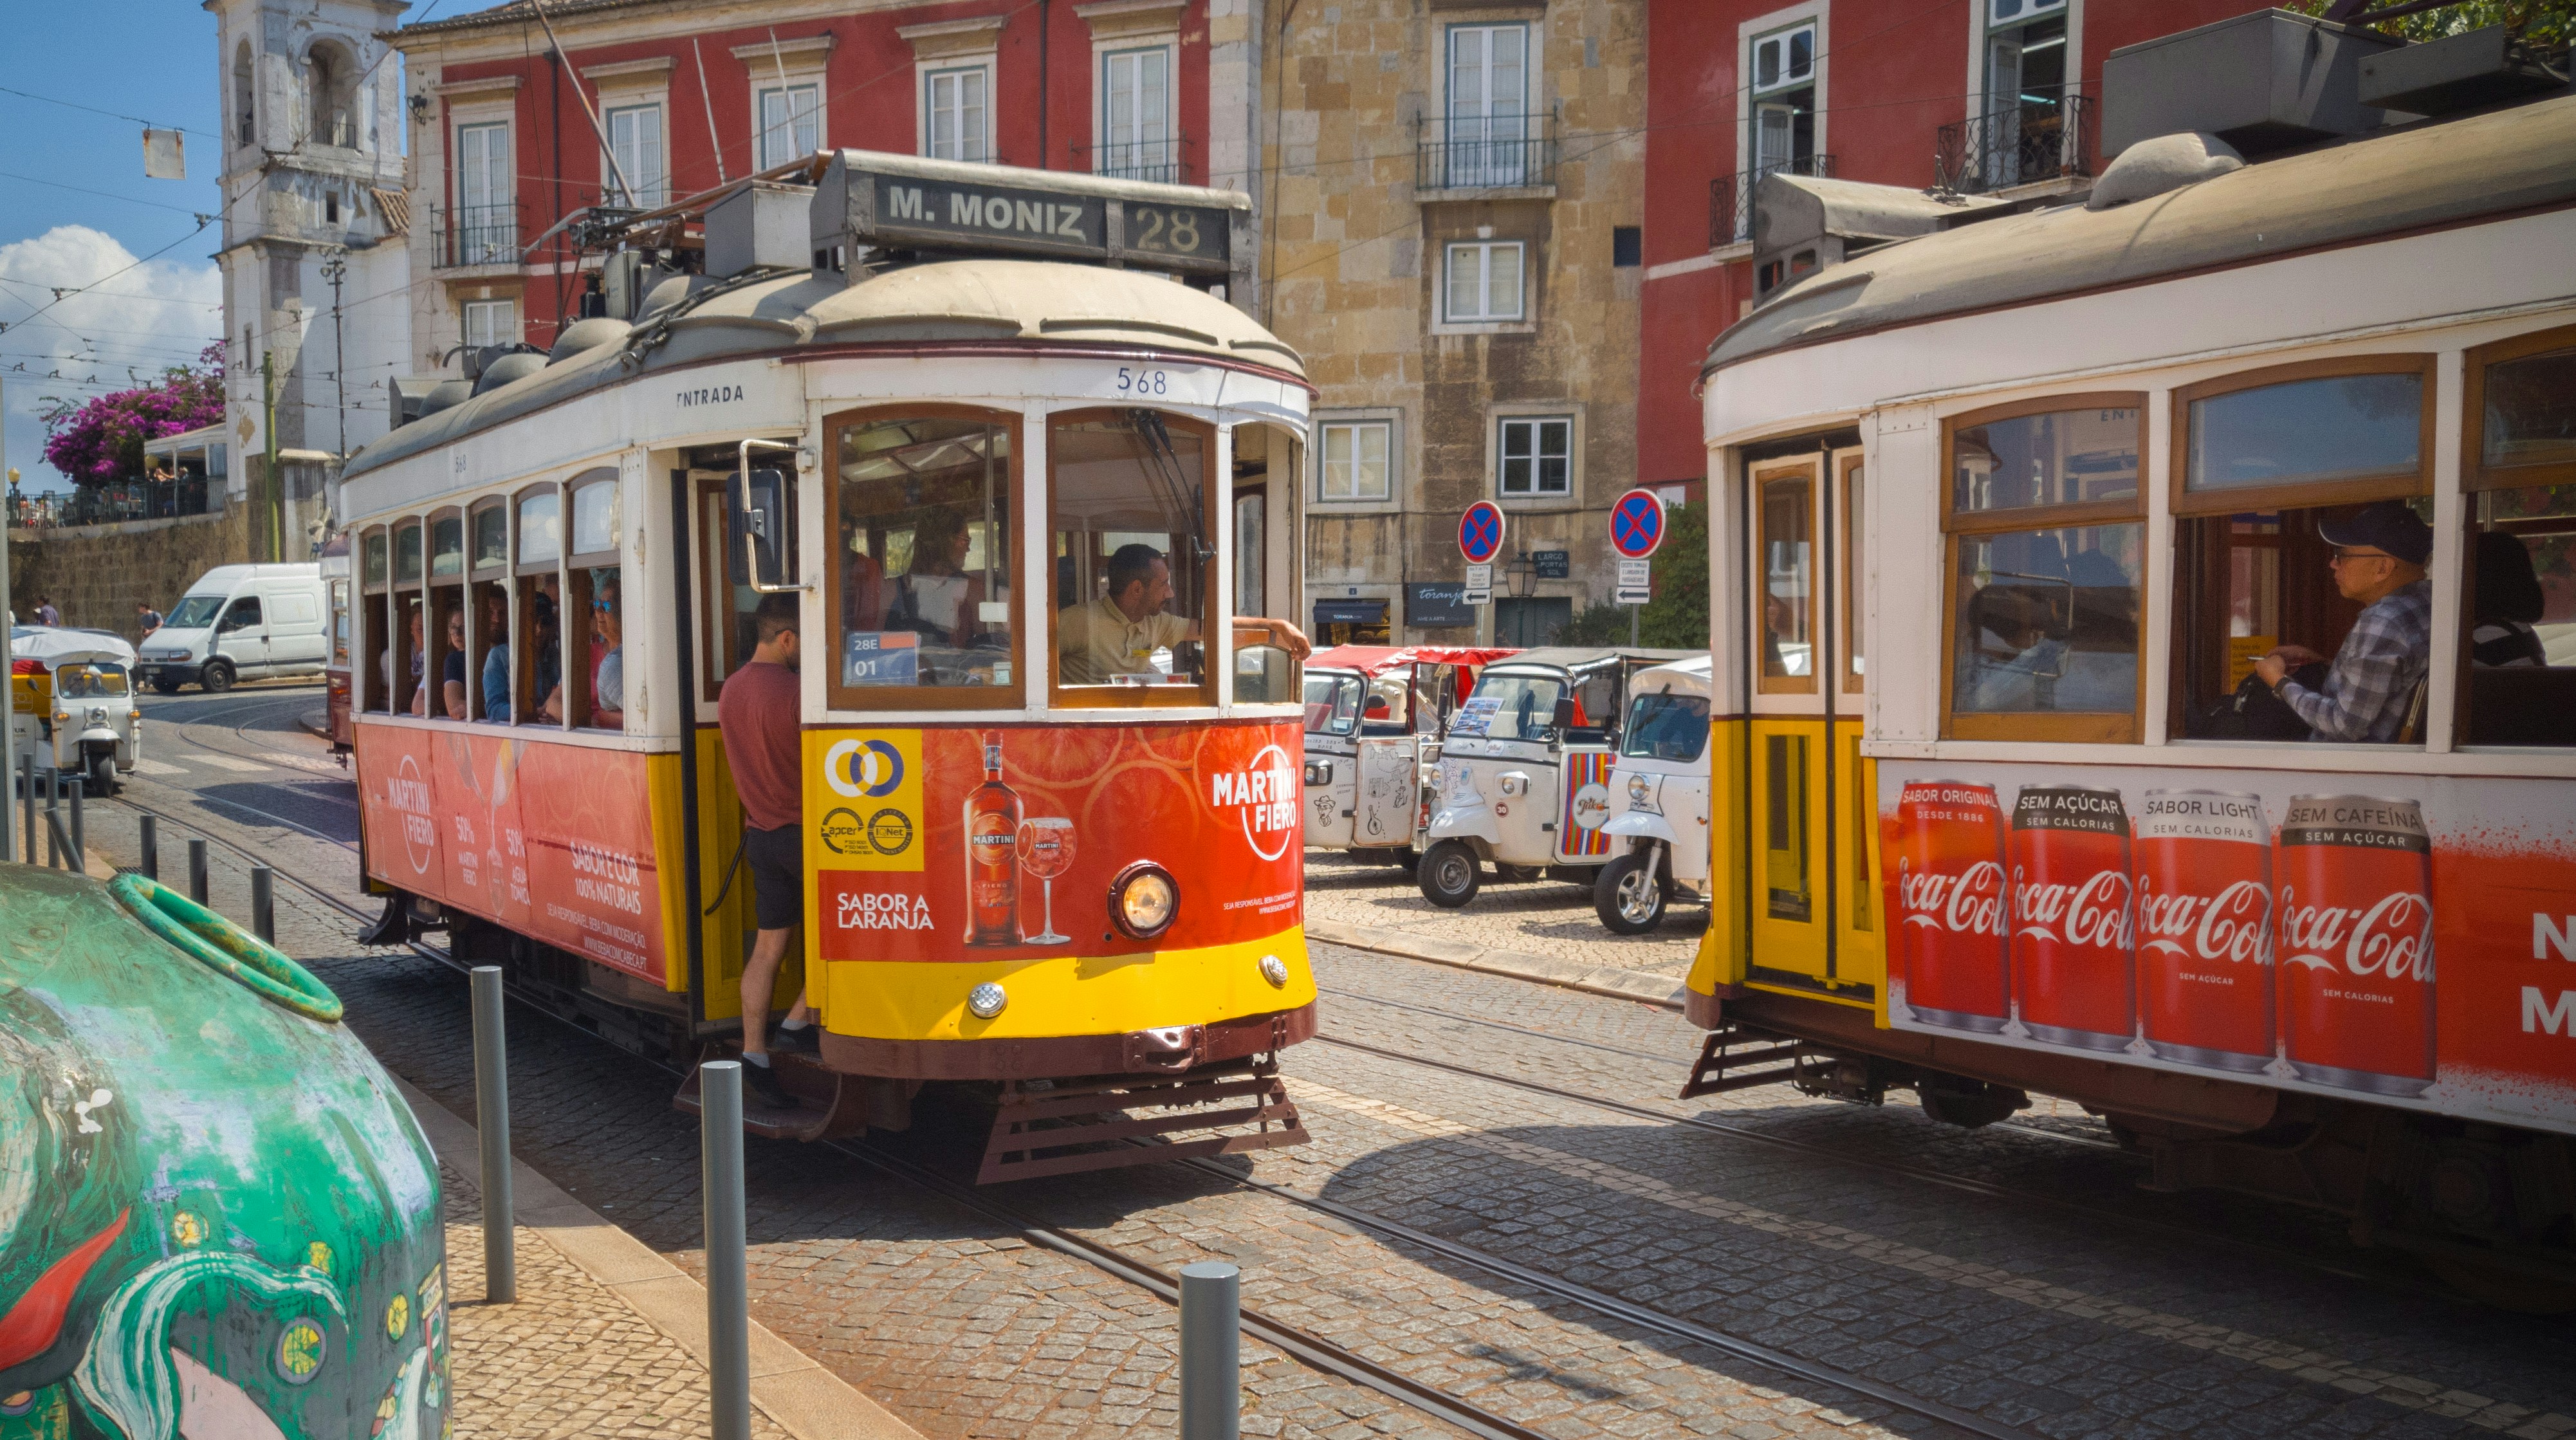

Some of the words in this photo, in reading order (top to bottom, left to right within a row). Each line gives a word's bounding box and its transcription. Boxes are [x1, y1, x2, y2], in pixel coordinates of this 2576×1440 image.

[890, 186, 935, 221] M.
[951, 192, 1086, 243] MONIZ
[1136, 207, 1200, 252] 28
[1118, 367, 1166, 394] 568
[456, 454, 466, 473] 568
[854, 639, 878, 651] 28E
[855, 660, 876, 676] 01
[387, 776, 430, 816] MARTINI
[1213, 768, 1296, 806] MARTINI
[1902, 789, 1938, 804] SABOR
[1942, 789, 1998, 808] ORIGINAL
[2020, 796, 2050, 809] SEM
[2055, 793, 2120, 815] AÇÚCAR
[1256, 801, 1296, 833] FIERO
[1917, 811, 1952, 820] DESDE
[1958, 813, 1984, 822] 1886
[2146, 800, 2202, 815] SABOR
[2209, 802, 2258, 820] LIGHT
[2290, 808, 2326, 822] SEM
[2334, 807, 2421, 829] CAFEÍNA
[407, 814, 434, 847] FIERO
[829, 827, 856, 837] apcer
[876, 828, 903, 836] IQNet
[2027, 817, 2048, 826] SEM
[2054, 818, 2114, 831] CALORIAS
[2154, 825, 2177, 833] SEM
[2185, 825, 2253, 838] CALORIAS
[973, 835, 1015, 844] MARTINI
[2306, 832, 2334, 841] SEM
[2343, 831, 2406, 846] AÇÚCAR
[571, 841, 607, 877] SABOR
[605, 851, 614, 879] E
[614, 853, 640, 886] COR
[575, 878, 596, 901] 100%
[596, 881, 641, 914] NATURAIS
[838, 892, 909, 912] SABOR
[913, 894, 930, 912] A
[838, 910, 934, 930] LARANJA
[2533, 912, 2576, 963] N
[2179, 972, 2195, 981] SEM
[2198, 975, 2234, 985] AÇÚCAR
[2323, 988, 2341, 997] SEM
[2344, 991, 2394, 1004] CALORIAS
[2521, 986, 2576, 1038] M
